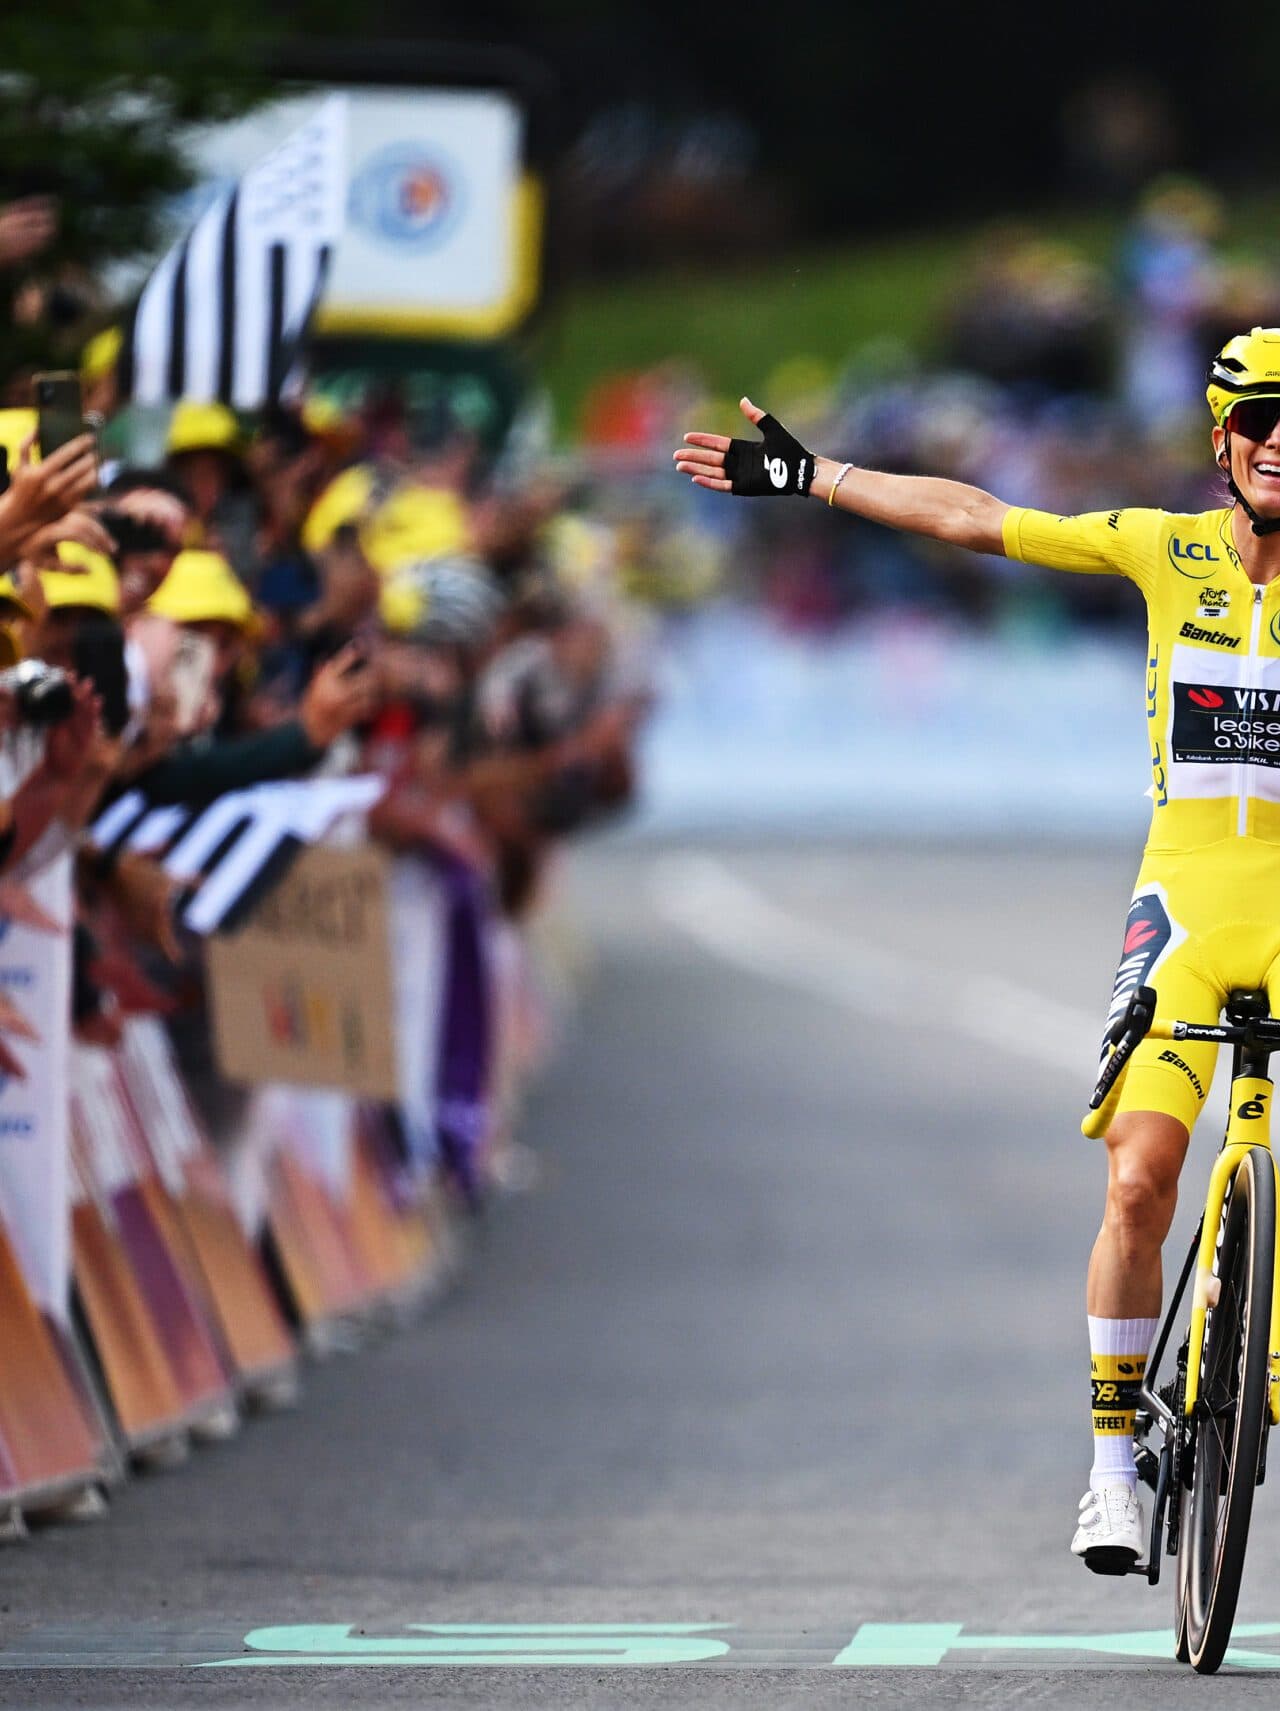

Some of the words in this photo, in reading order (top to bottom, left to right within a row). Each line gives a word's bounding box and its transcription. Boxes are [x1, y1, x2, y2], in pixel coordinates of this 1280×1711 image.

[1172, 538, 1220, 562] LCL
[1178, 621, 1242, 649] Santini
[1147, 643, 1159, 718] LCL
[1152, 742, 1168, 808] LCL
[1157, 1049, 1205, 1100] Santini
